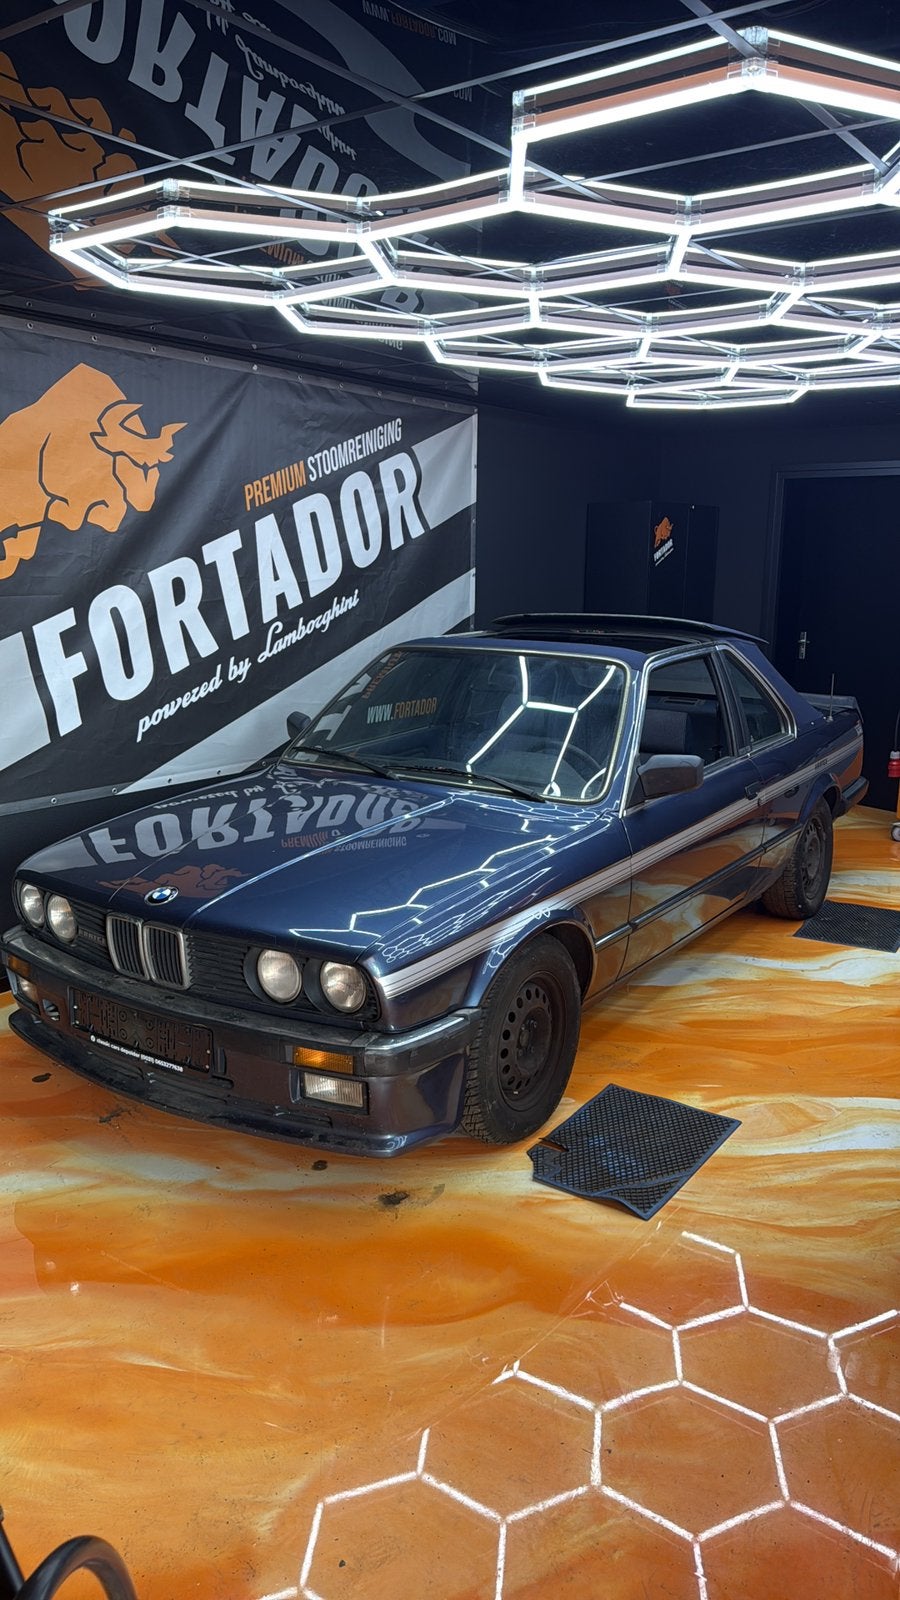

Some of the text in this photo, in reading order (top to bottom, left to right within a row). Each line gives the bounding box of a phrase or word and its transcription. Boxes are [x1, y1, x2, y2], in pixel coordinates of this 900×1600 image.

[244, 418, 402, 511] PREMIUM STOOMREINIGING
[32, 452, 425, 737] FORTADOR
[136, 589, 359, 742] powered by Lamborghini
